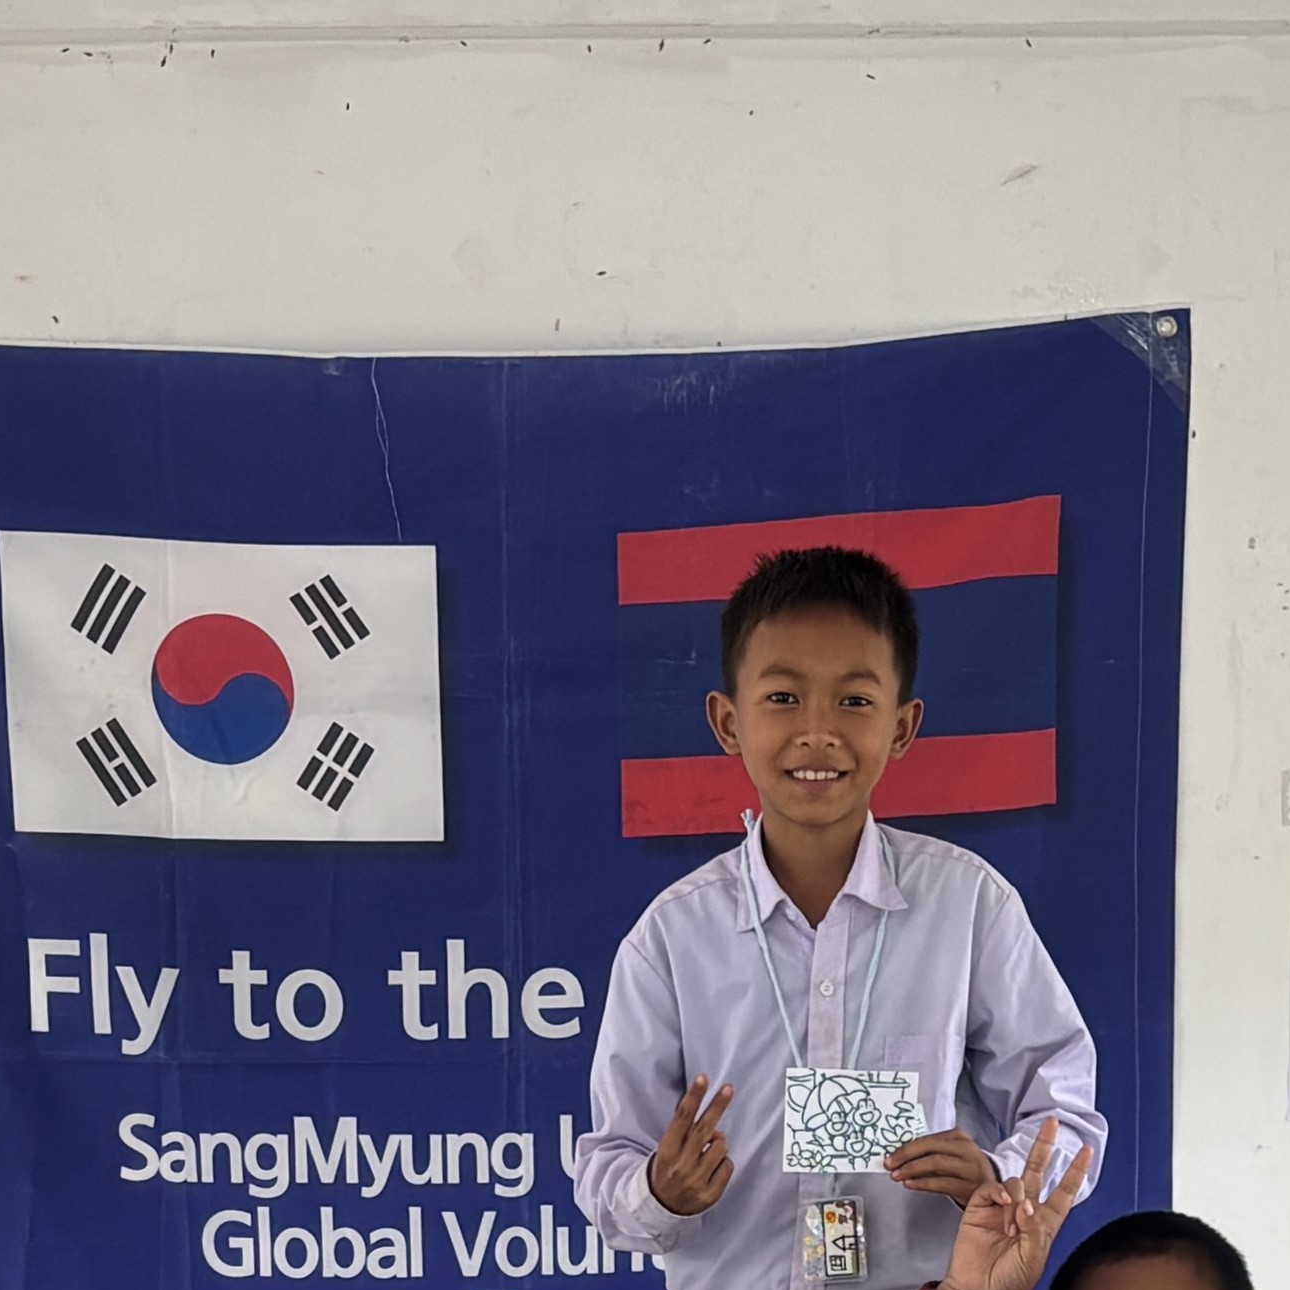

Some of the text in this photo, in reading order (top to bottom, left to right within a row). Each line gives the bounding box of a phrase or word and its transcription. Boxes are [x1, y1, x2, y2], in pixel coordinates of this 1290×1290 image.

[27, 932, 585, 1055] Fly to the
[118, 1112, 535, 1198] SangMyung
[201, 1204, 666, 1279] Global Volu
